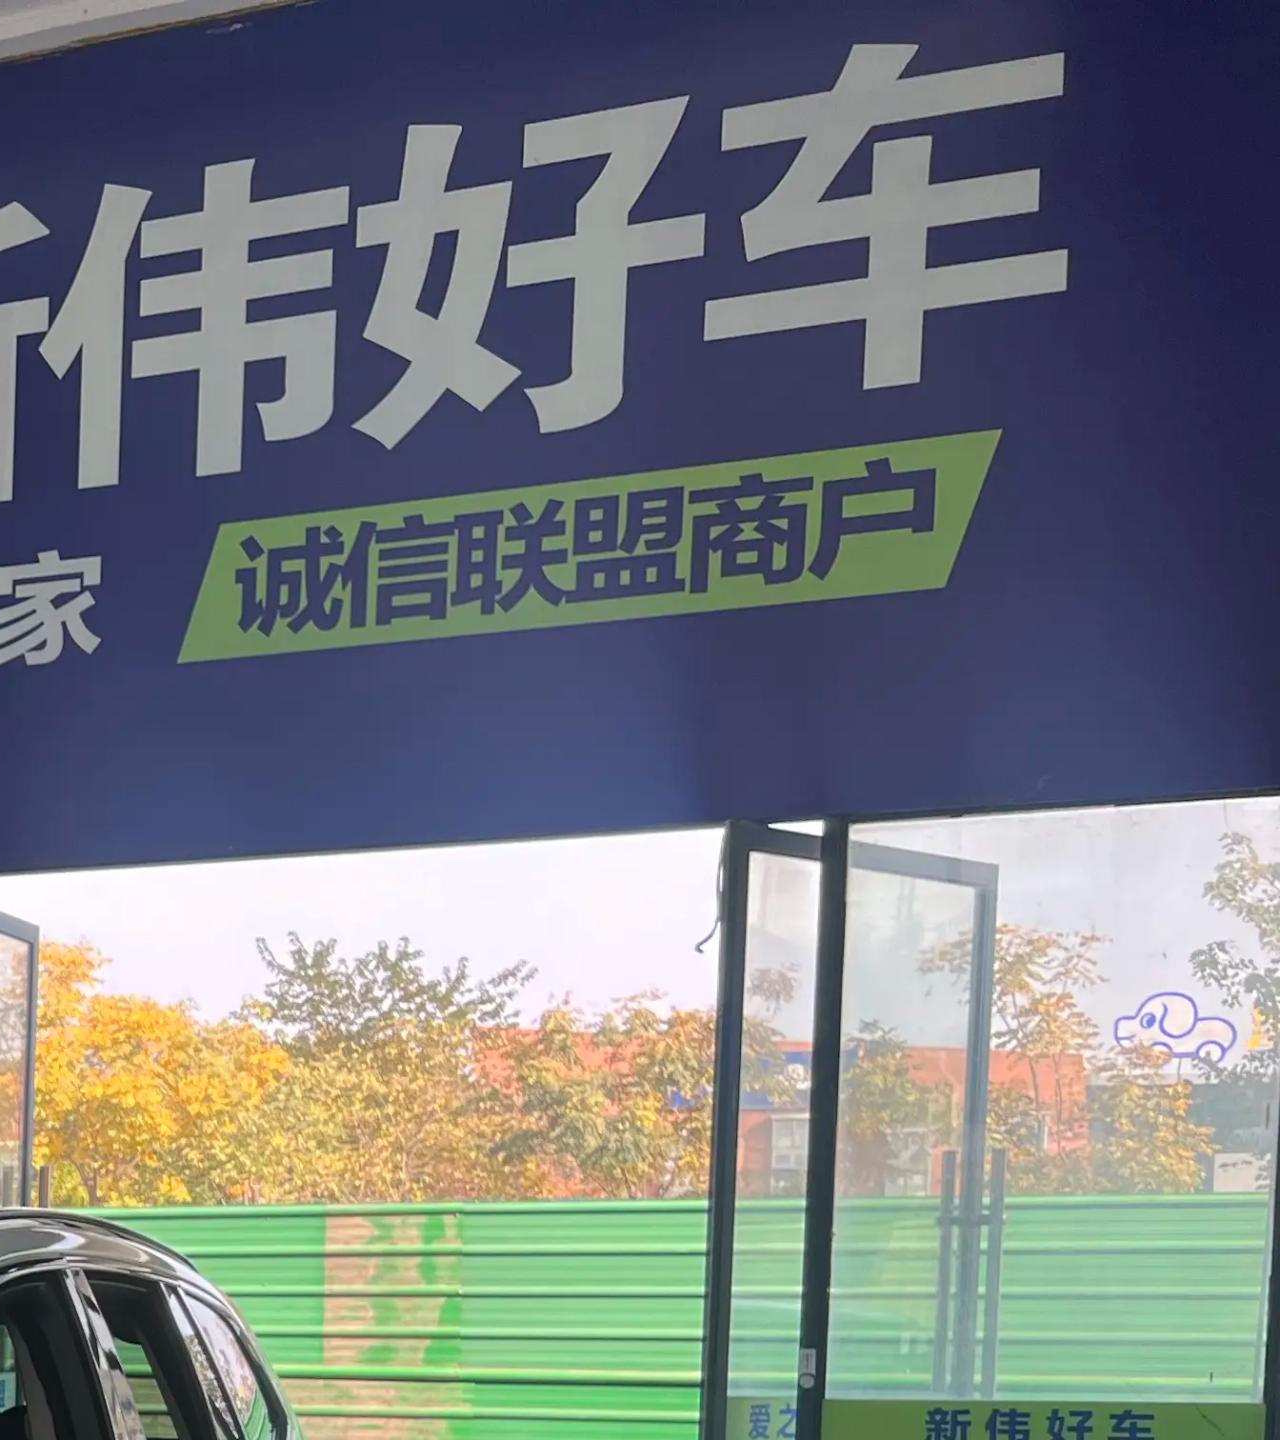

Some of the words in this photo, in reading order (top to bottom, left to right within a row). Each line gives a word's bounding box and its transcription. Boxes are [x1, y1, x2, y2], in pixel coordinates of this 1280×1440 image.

[235, 457, 939, 636] 诚信联盟商户
